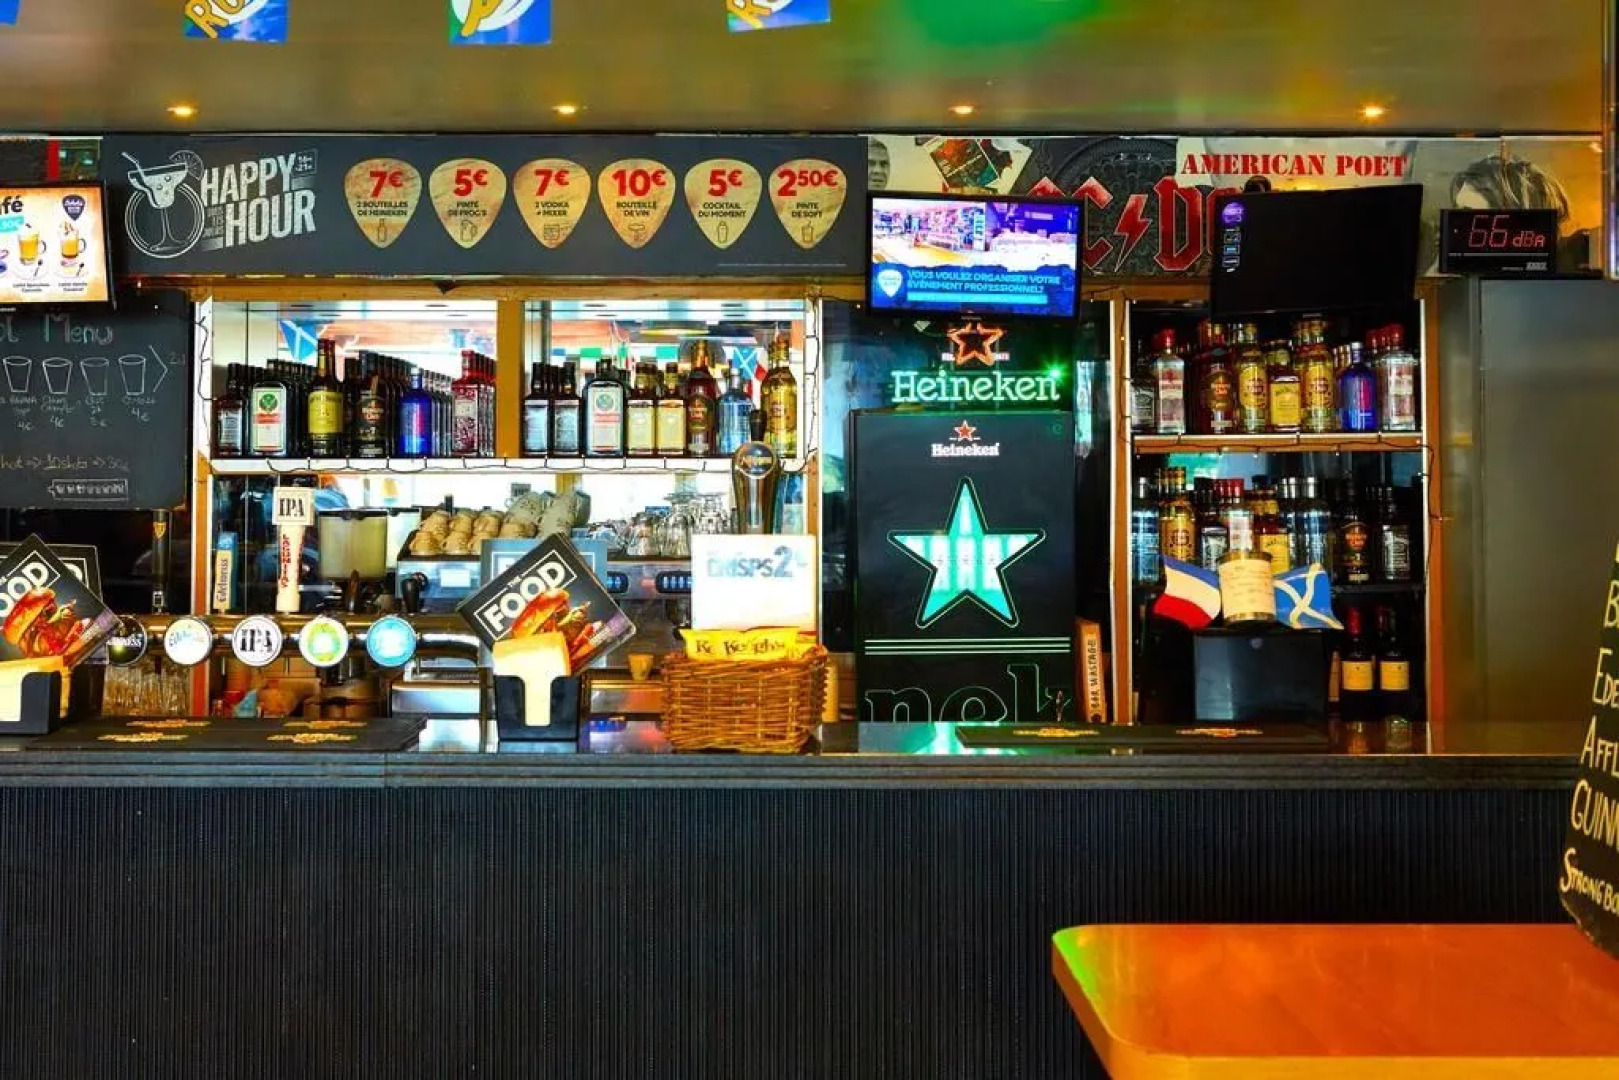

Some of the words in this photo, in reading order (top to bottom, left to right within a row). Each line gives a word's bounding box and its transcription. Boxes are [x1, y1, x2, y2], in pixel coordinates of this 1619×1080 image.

[200, 152, 297, 207] HAPPY
[1181, 153, 1326, 176] AMERICAN
[1335, 154, 1408, 178] POET
[369, 170, 405, 198] 7€
[453, 168, 488, 197] 5€
[535, 168, 570, 197] 7€
[612, 168, 667, 197] 10€
[708, 168, 743, 197] 5€
[363, 200, 409, 208] BOUTEILLES
[369, 209, 408, 217] HEINEKEN
[457, 200, 480, 208] PINTE
[616, 200, 658, 208] BOUTEILLE
[698, 210, 710, 218] DU
[711, 210, 746, 218] MOMENT
[225, 189, 317, 248] HOUR
[1468, 214, 1511, 248] 66
[1512, 230, 1546, 248] dBA
[908, 269, 934, 280] VOUS
[935, 271, 973, 281] VOULEZ
[973, 273, 1028, 284] ORGANISER
[1029, 275, 1061, 286] VOTRE
[45, 313, 114, 346] Menu
[890, 369, 1060, 403] Heineken
[931, 442, 1000, 458] Heineken
[277, 497, 305, 517] IPA
[483, 560, 566, 632] FOOD
[240, 627, 274, 654] IPA
